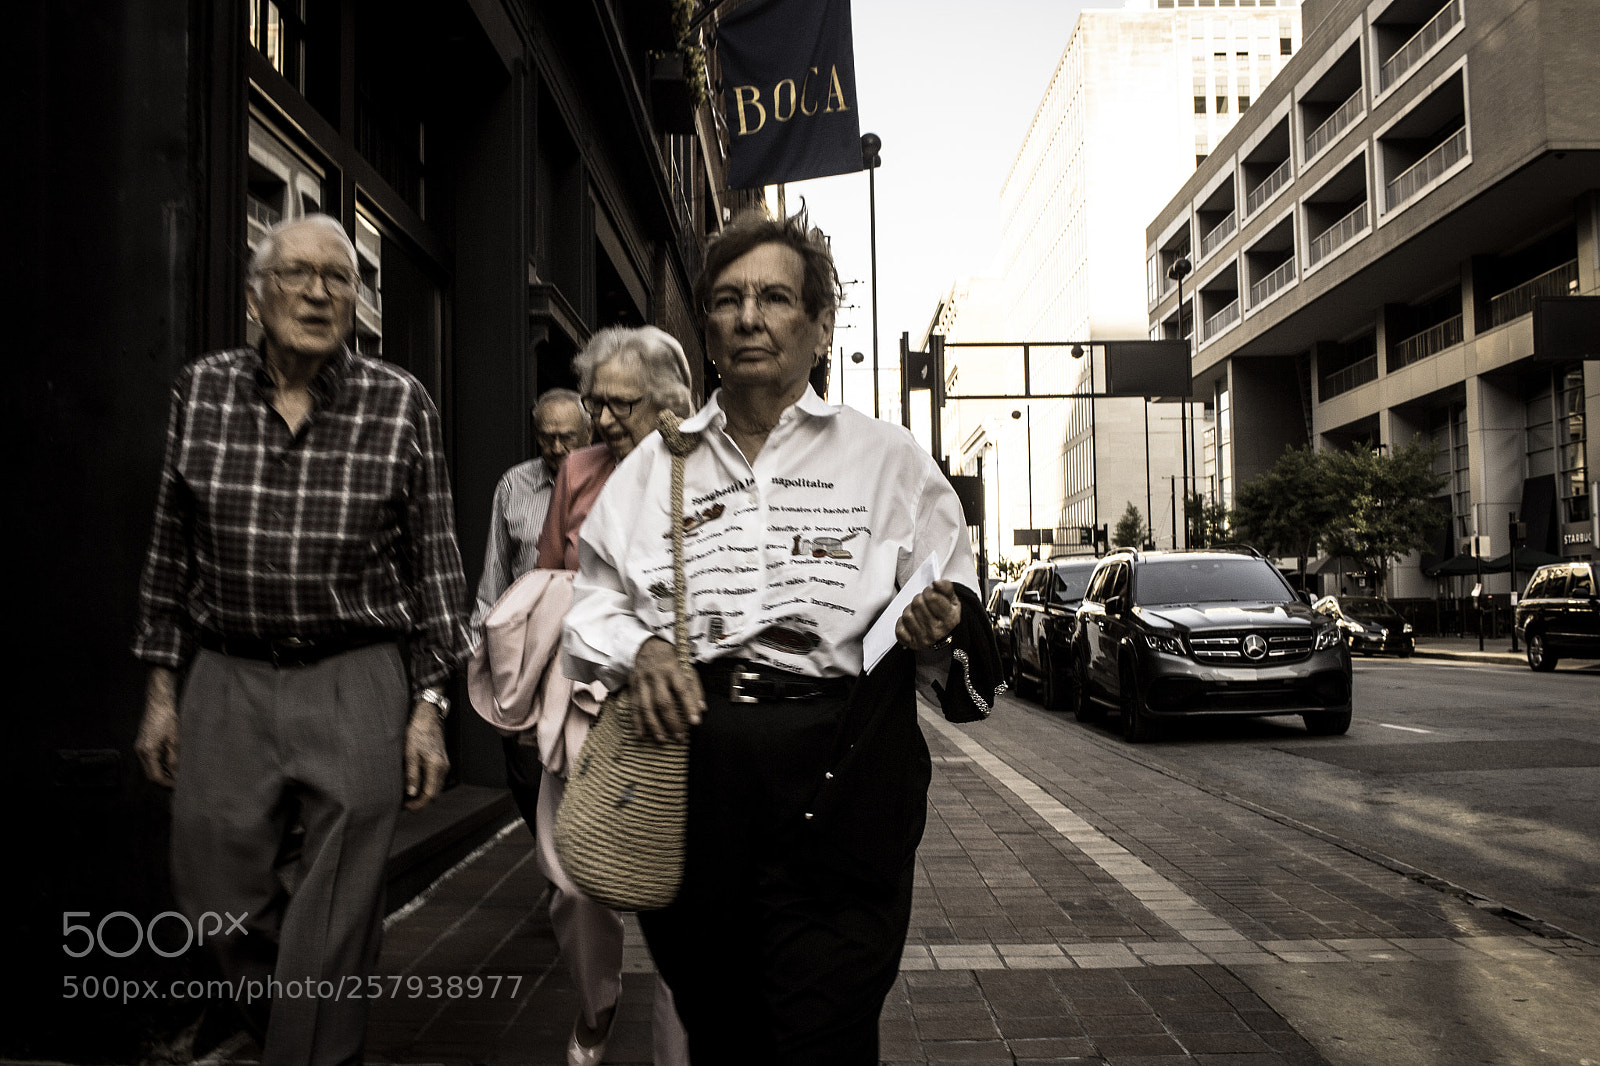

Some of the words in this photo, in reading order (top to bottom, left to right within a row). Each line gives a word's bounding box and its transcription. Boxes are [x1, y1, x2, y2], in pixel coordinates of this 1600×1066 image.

[733, 64, 850, 136] BOCA
[771, 476, 835, 490] napolitaine
[1564, 533, 1592, 545] STARBUC
